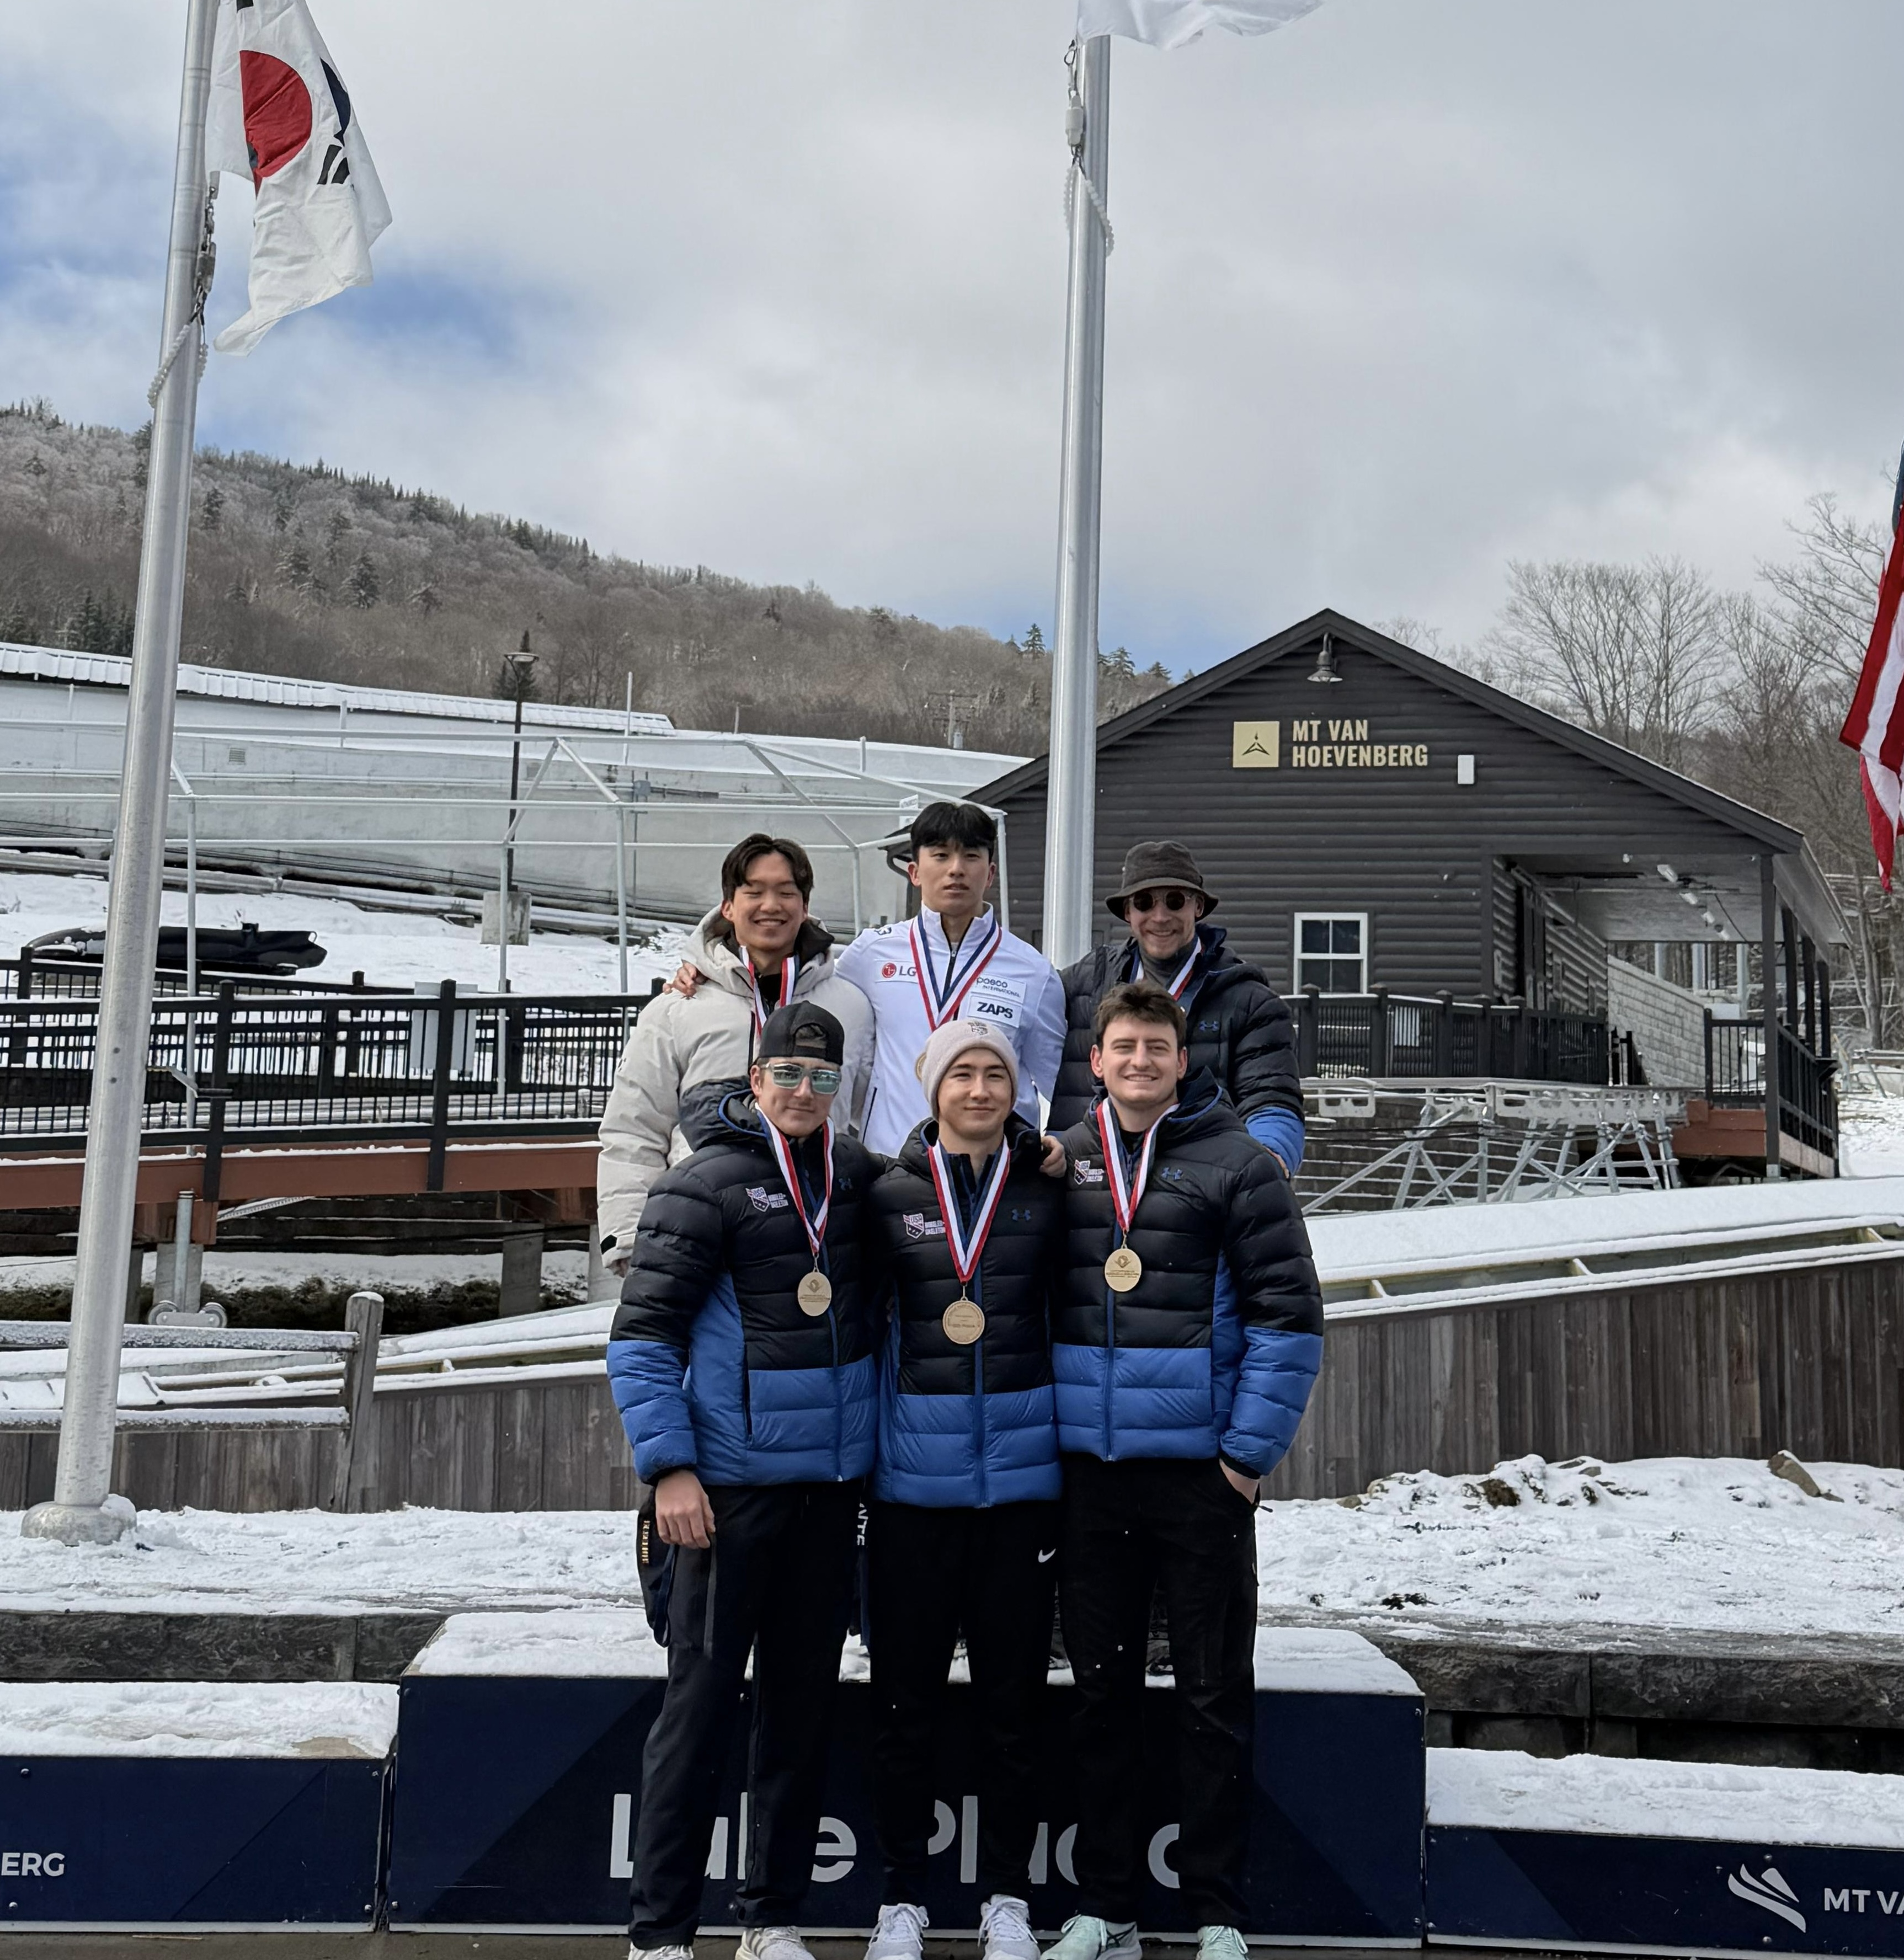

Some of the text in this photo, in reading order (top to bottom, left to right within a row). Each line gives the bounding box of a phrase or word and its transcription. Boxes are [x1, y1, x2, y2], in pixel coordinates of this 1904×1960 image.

[1293, 719, 1368, 741] MT VAN
[1292, 744, 1428, 767] HOEVENBERG
[899, 965, 917, 976] LG
[977, 977, 1008, 988] posco
[977, 1001, 1014, 1019] ZAPS
[1, 1852, 65, 1877] ERG
[1824, 1888, 1871, 1913] MT
